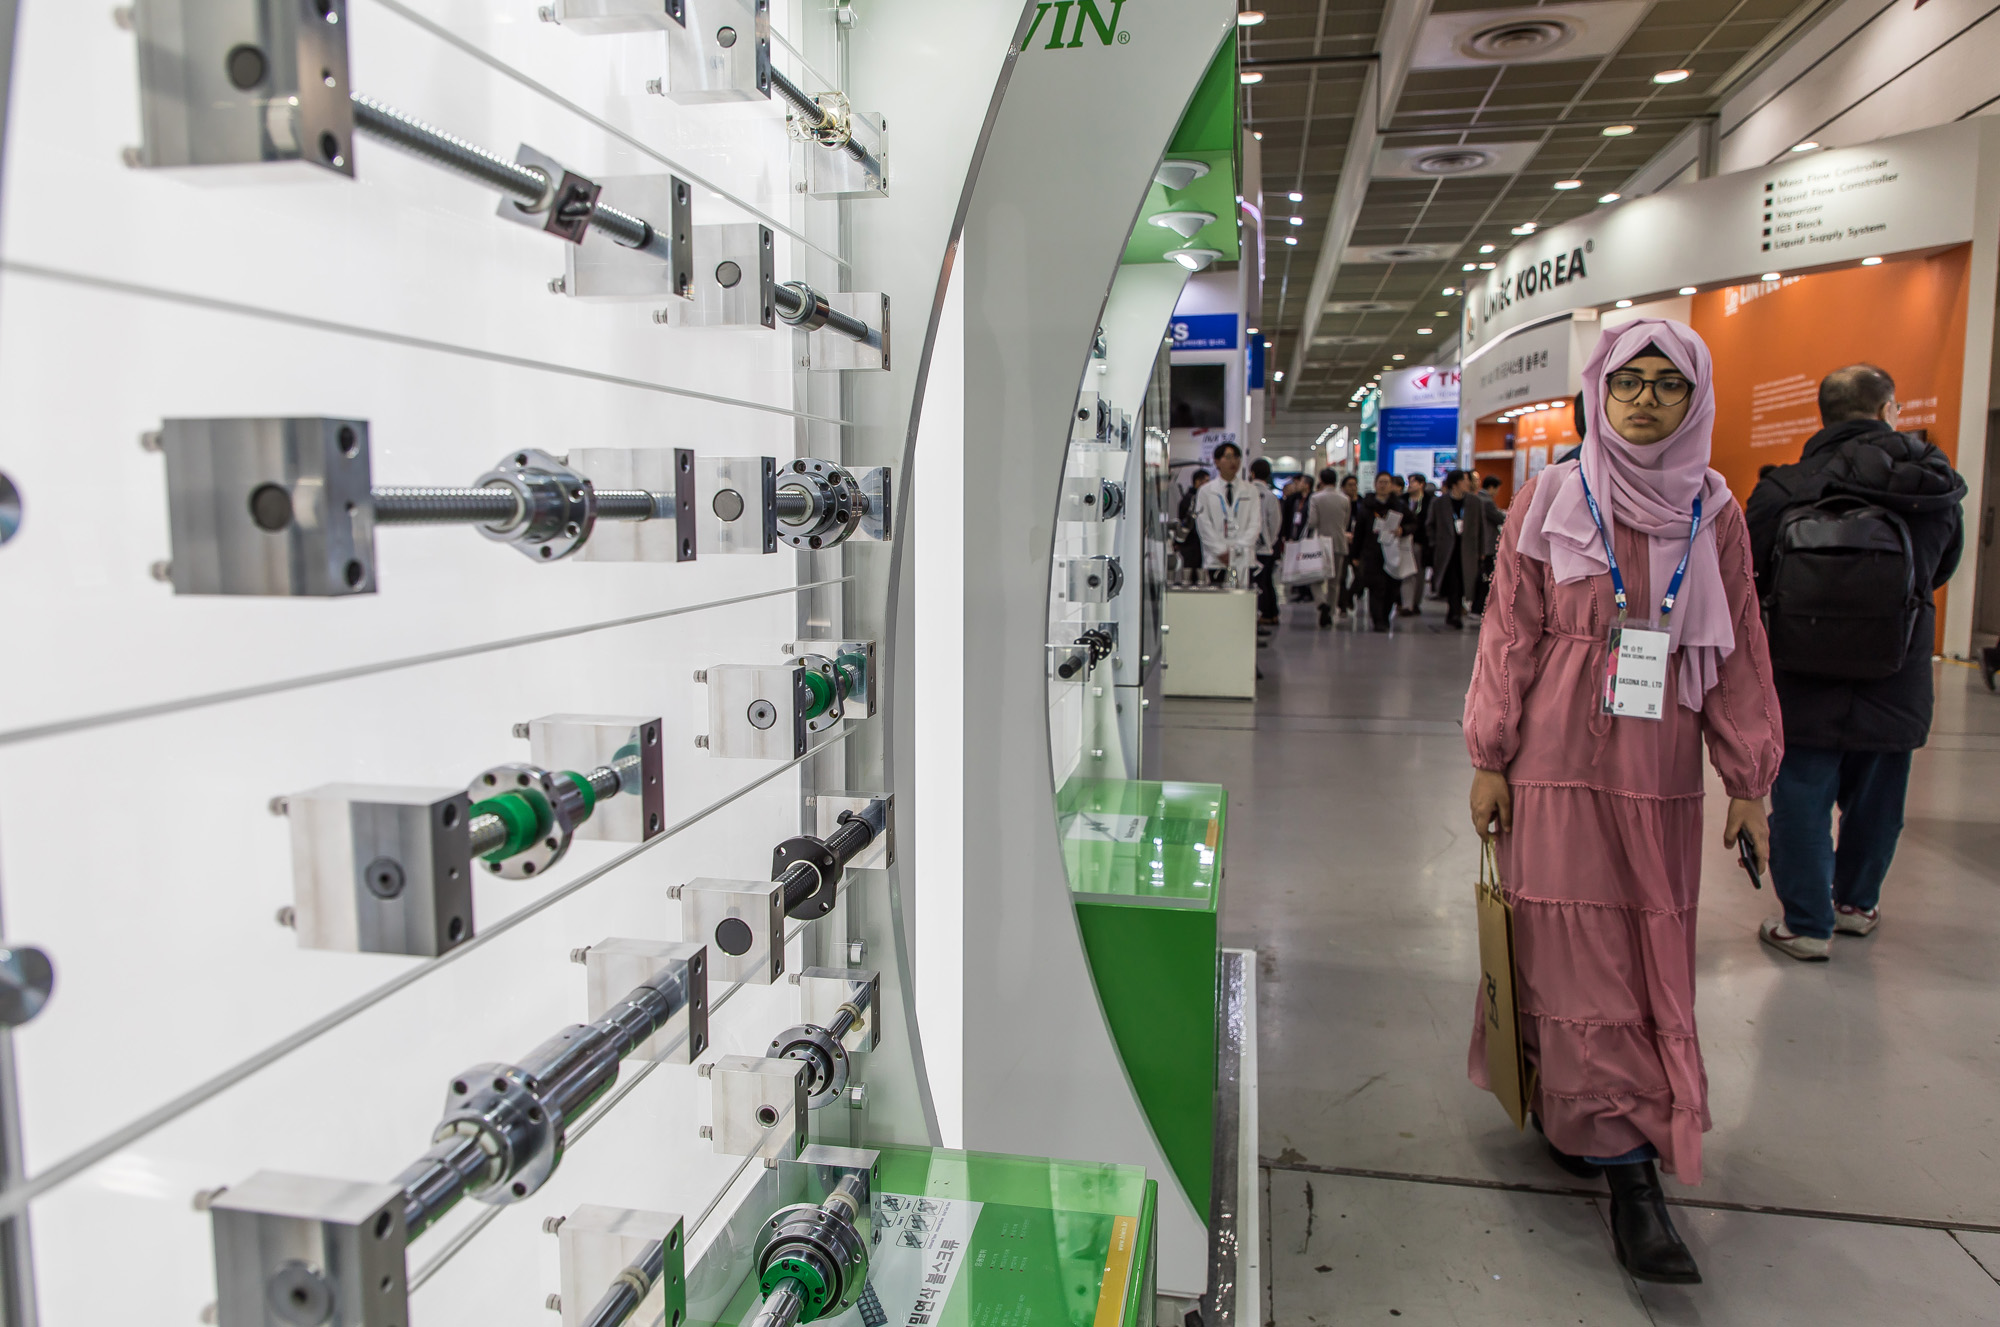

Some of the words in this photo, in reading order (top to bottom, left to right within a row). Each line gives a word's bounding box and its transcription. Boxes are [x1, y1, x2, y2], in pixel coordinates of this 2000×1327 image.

[1515, 247, 1587, 301] KOREA
[905, 1287, 941, 1327] 밀연삭
[925, 1239, 960, 1284] 볼스크류
